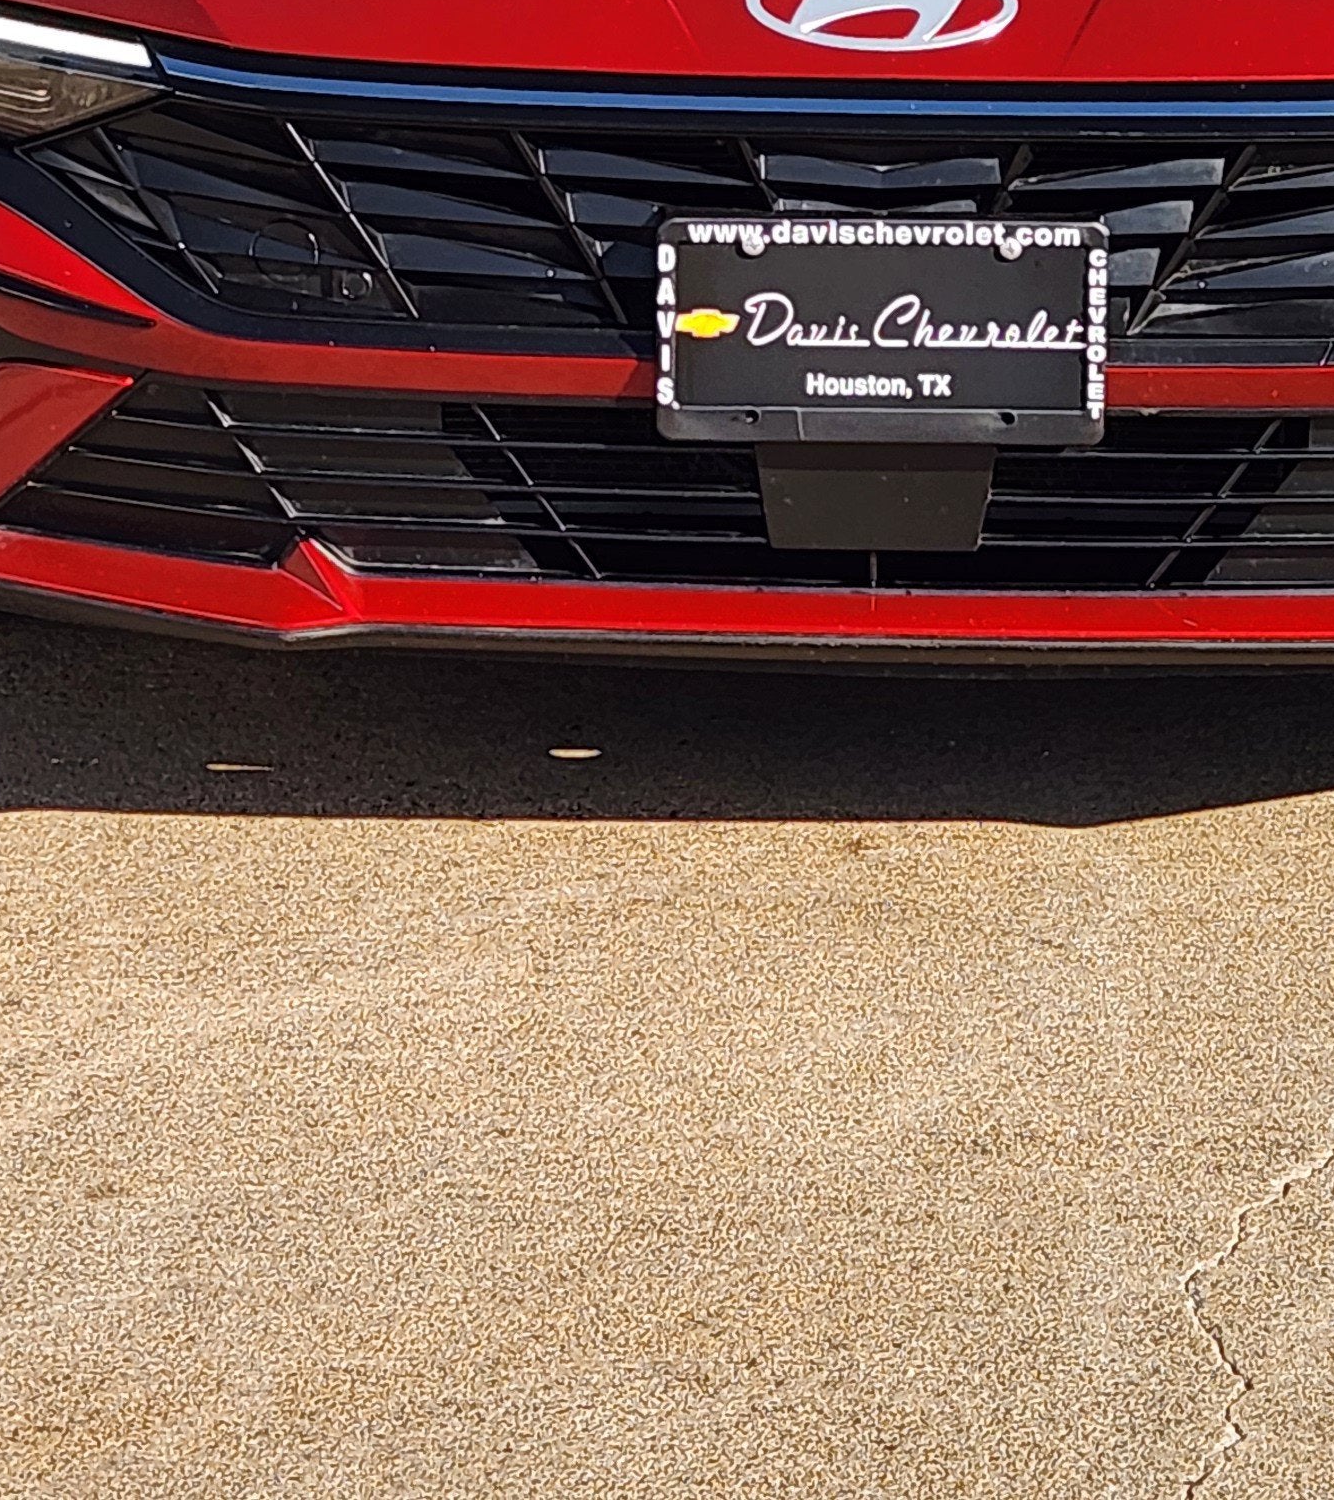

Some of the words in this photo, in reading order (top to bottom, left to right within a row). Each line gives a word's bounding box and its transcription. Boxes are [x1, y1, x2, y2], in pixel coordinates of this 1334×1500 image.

[687, 219, 1082, 247] www.davischevrolet.com
[656, 243, 677, 405] DAVIS
[744, 292, 871, 347] Davis
[873, 294, 1087, 349] Chevrolet
[1086, 249, 1107, 420] CHEVROLET
[806, 372, 913, 399] Houston,
[917, 373, 952, 396] TX
